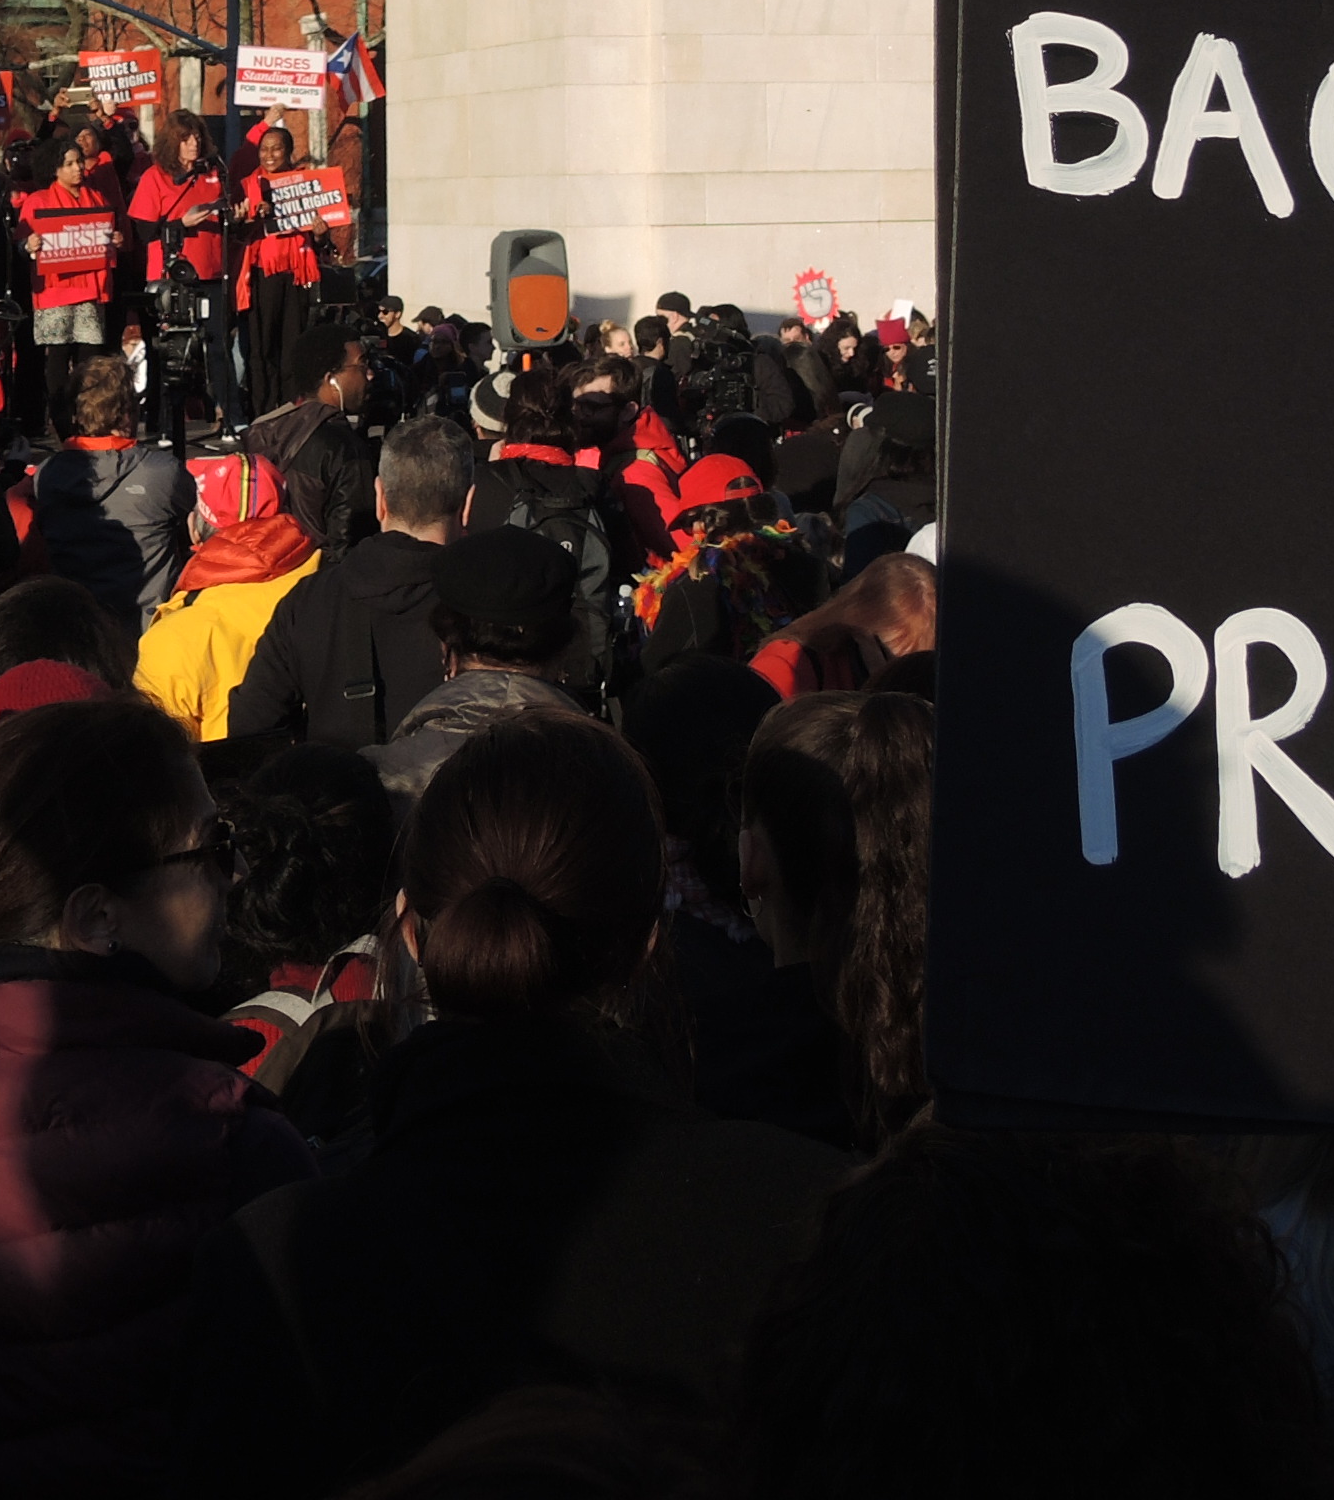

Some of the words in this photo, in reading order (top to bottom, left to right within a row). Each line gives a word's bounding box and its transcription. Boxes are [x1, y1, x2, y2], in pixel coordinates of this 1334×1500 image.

[88, 62, 128, 79] JUSTICE
[129, 60, 138, 72] &
[253, 56, 310, 70] NURSES
[90, 79, 117, 92] CIVIL
[117, 71, 156, 89] RIGHTS
[242, 70, 294, 85] Standing
[296, 74, 318, 84] Tall
[113, 90, 131, 104] ALL
[290, 88, 319, 96] RIGHTS
[312, 179, 321, 192] &
[274, 200, 302, 217] CIVIL
[302, 190, 342, 210] RIGHTS
[40, 246, 106, 258] ASSOCIATIO
